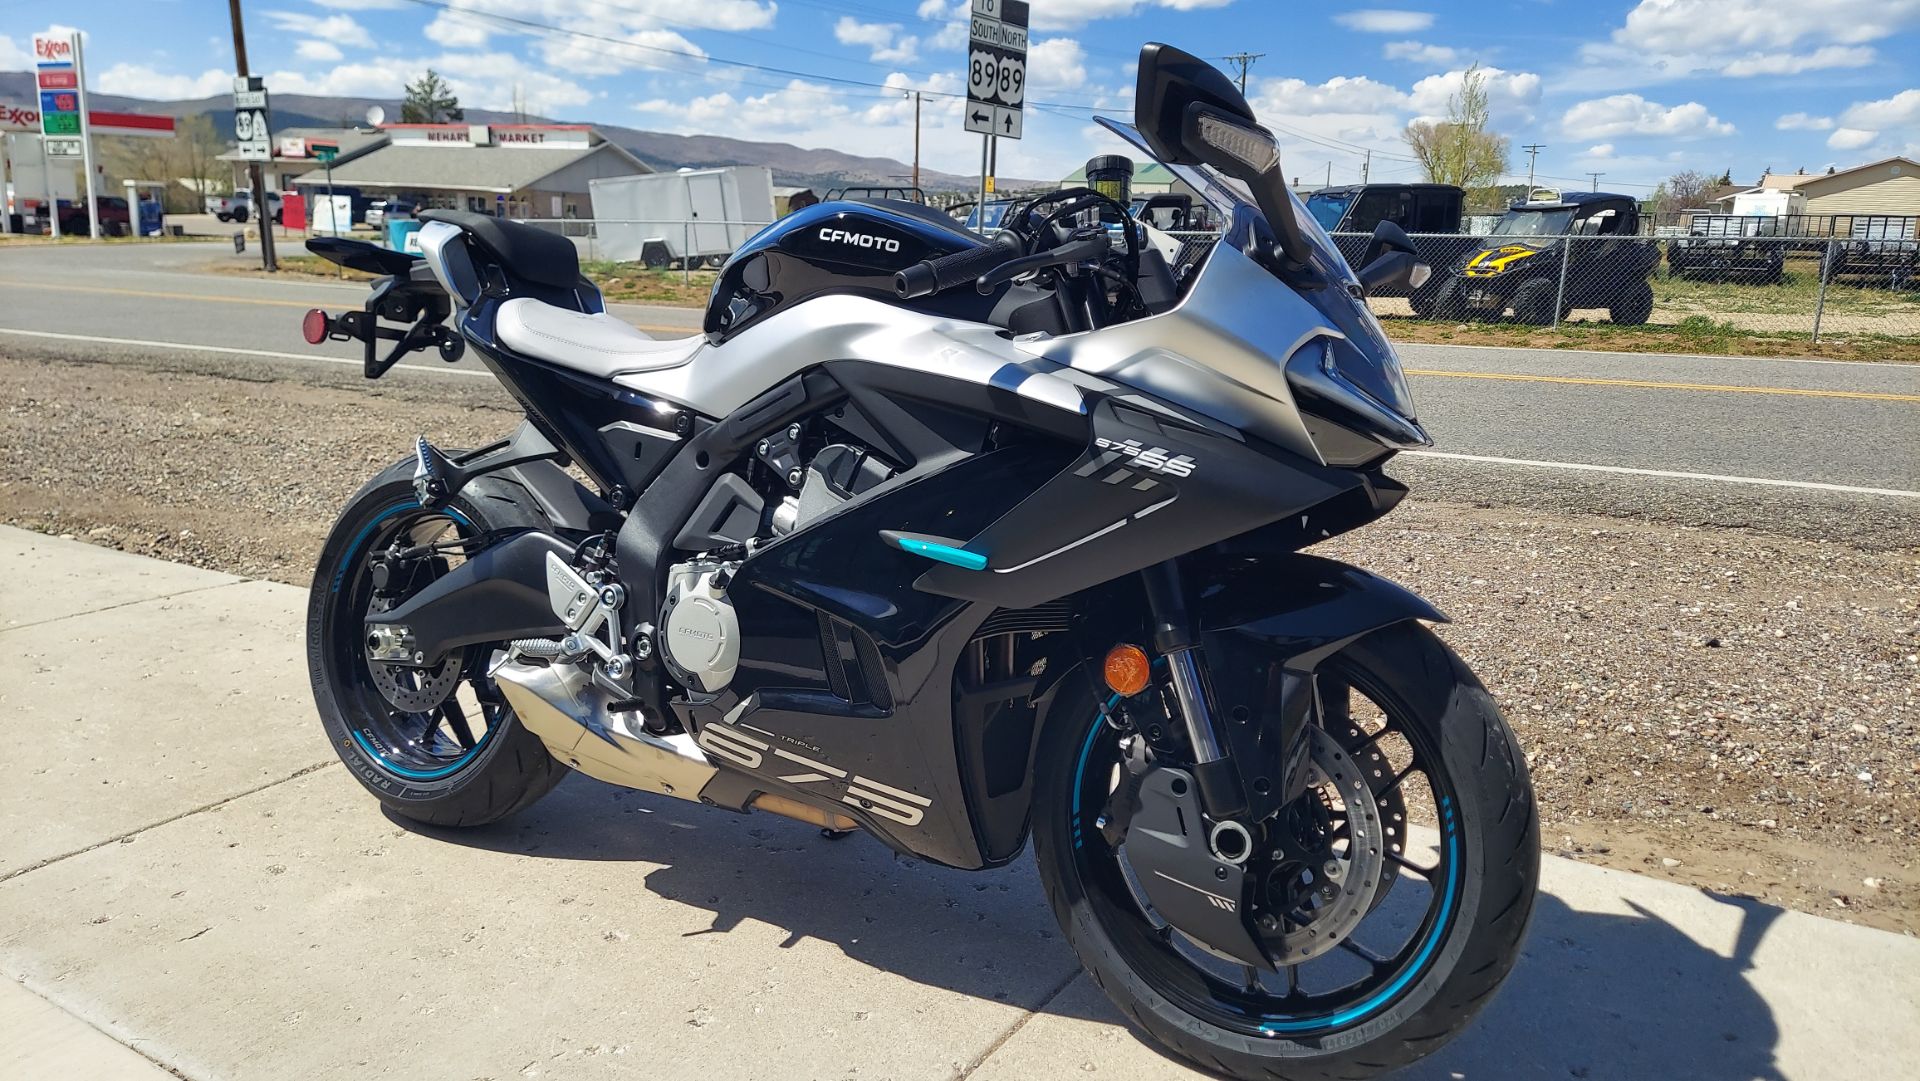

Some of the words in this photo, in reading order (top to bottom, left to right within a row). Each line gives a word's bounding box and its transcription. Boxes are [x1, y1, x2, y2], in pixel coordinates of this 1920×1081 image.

[972, 20, 998, 40] SOUTH
[1001, 26, 1027, 48] NORTH
[35, 38, 70, 59] Exxon
[971, 59, 995, 88] 89
[1000, 67, 1023, 94] 89
[499, 132, 544, 143] MARKET
[819, 227, 900, 253] CFMOTO
[1095, 437, 1142, 457] 675
[1134, 450, 1197, 478] SS
[678, 627, 714, 641] CFMOTO
[362, 727, 391, 756] CFMOTO
[781, 735, 821, 752] TRIPLE
[346, 751, 392, 789] RADIAL
[698, 722, 933, 826] 675
